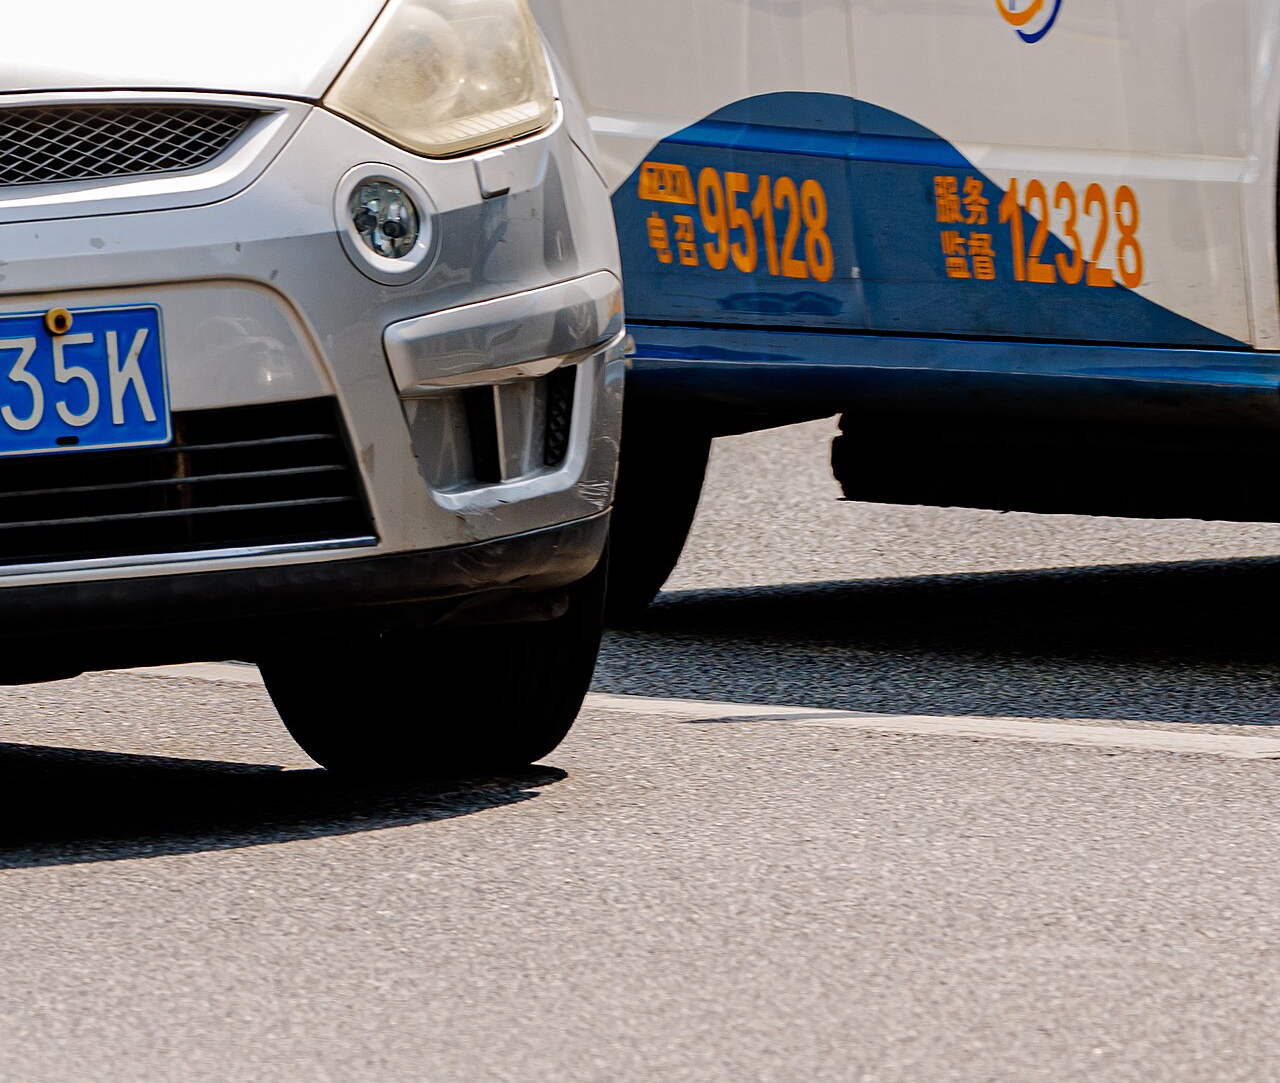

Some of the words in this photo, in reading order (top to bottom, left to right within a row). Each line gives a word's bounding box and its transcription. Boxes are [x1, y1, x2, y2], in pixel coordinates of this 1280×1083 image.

[698, 167, 834, 282] 95128
[934, 176, 990, 225] 服务
[647, 211, 699, 265] 电召
[941, 230, 996, 280] 监督
[998, 177, 1144, 288] 12328
